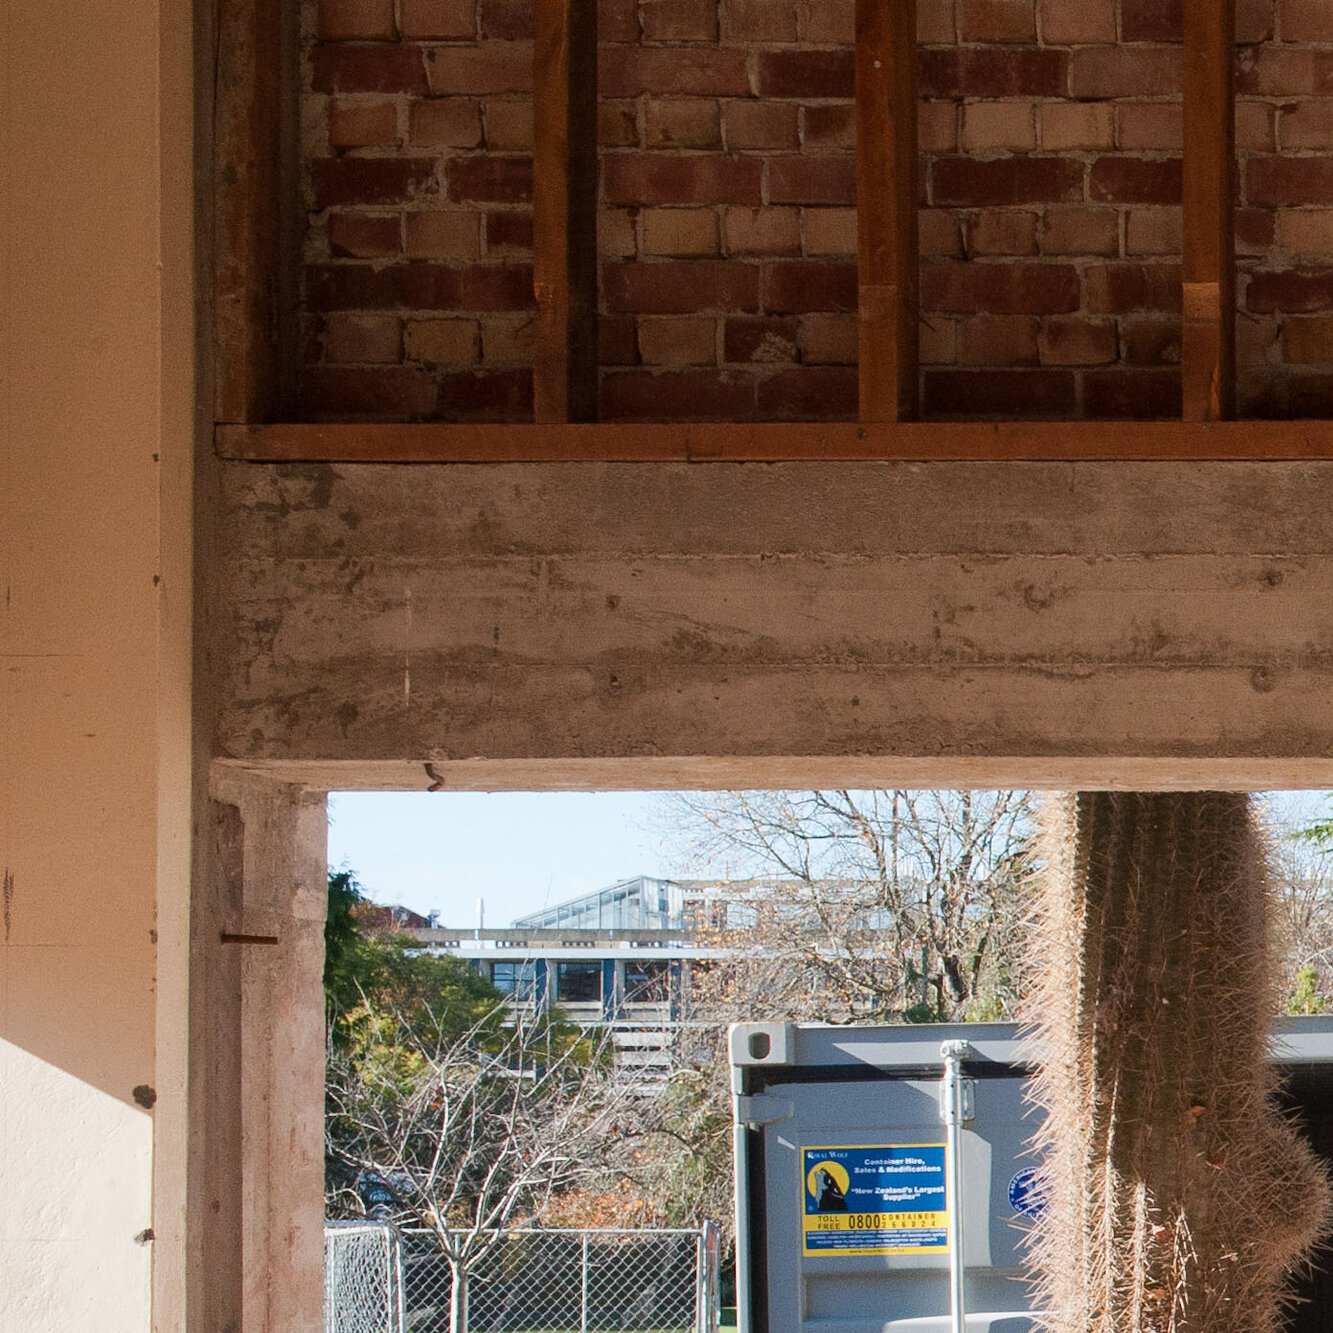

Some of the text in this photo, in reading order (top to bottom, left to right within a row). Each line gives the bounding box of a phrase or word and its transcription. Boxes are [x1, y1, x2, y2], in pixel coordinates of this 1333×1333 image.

[886, 1165, 941, 1173] Modifications
[914, 1186, 945, 1195] Largest
[848, 1214, 880, 1229] 0800
